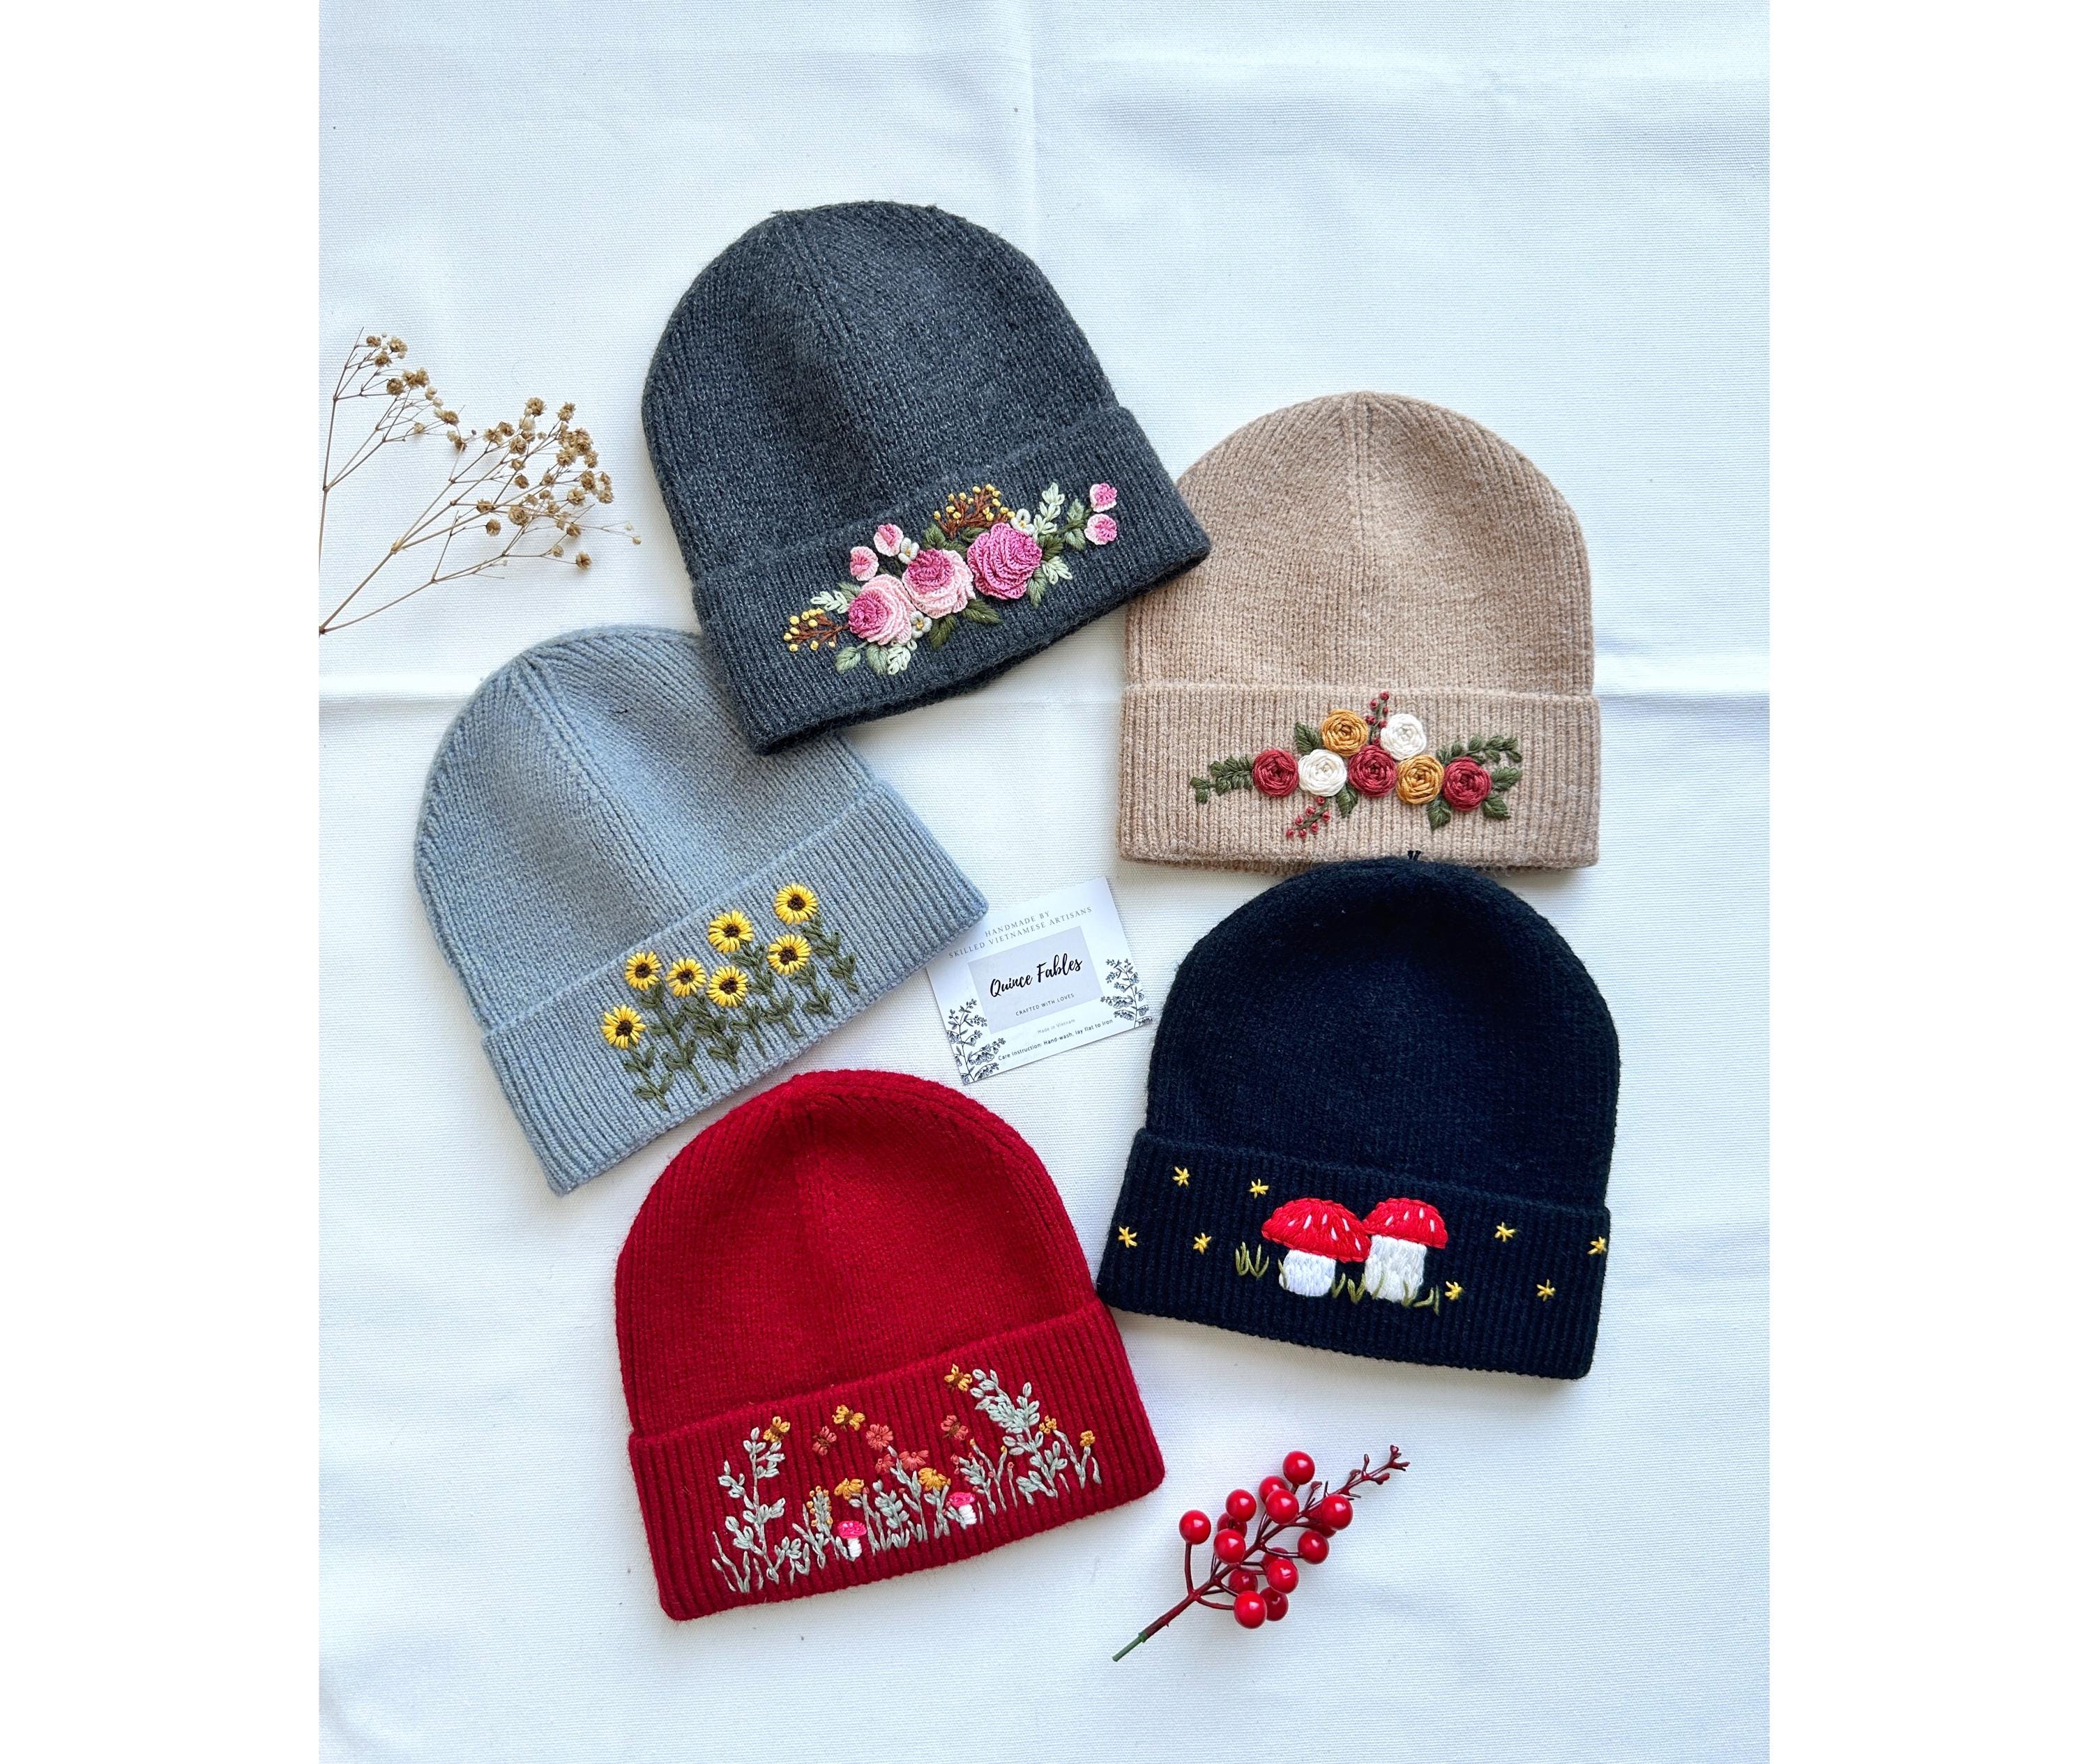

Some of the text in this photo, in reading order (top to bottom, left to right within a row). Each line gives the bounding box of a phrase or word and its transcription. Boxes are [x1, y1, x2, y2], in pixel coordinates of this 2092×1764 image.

[948, 906, 1092, 959] SKILLED VIETNAMESE ARTISANS
[985, 911, 1049, 937] HANDMADE BY
[990, 953, 1083, 997] Quince Fables
[1015, 1005, 1040, 1016] CRAFTED
[1057, 993, 1075, 1003] LOVES
[1056, 1019, 1075, 1028] Vietnam
